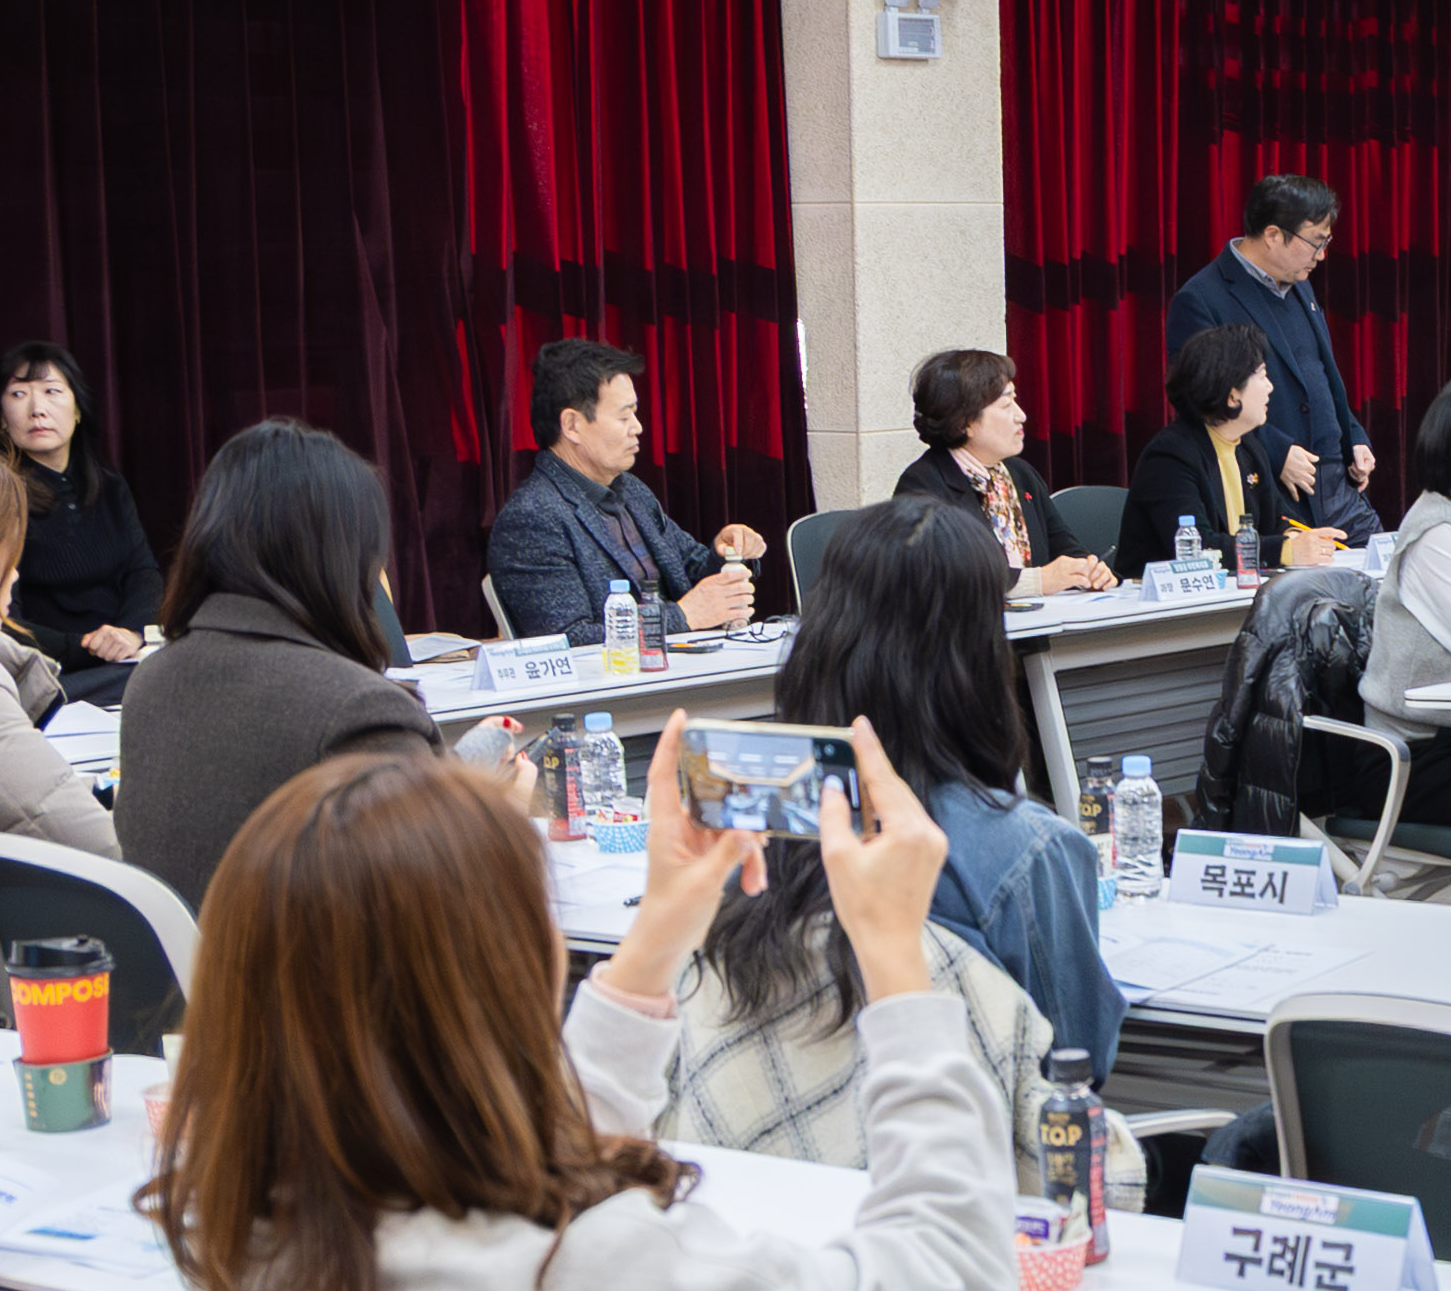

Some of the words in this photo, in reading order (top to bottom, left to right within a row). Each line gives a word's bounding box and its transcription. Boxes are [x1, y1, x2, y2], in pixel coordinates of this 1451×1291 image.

[1180, 574, 1215, 593] 문수연
[525, 656, 573, 680] 윤가연
[1200, 864, 1289, 905] 목포시
